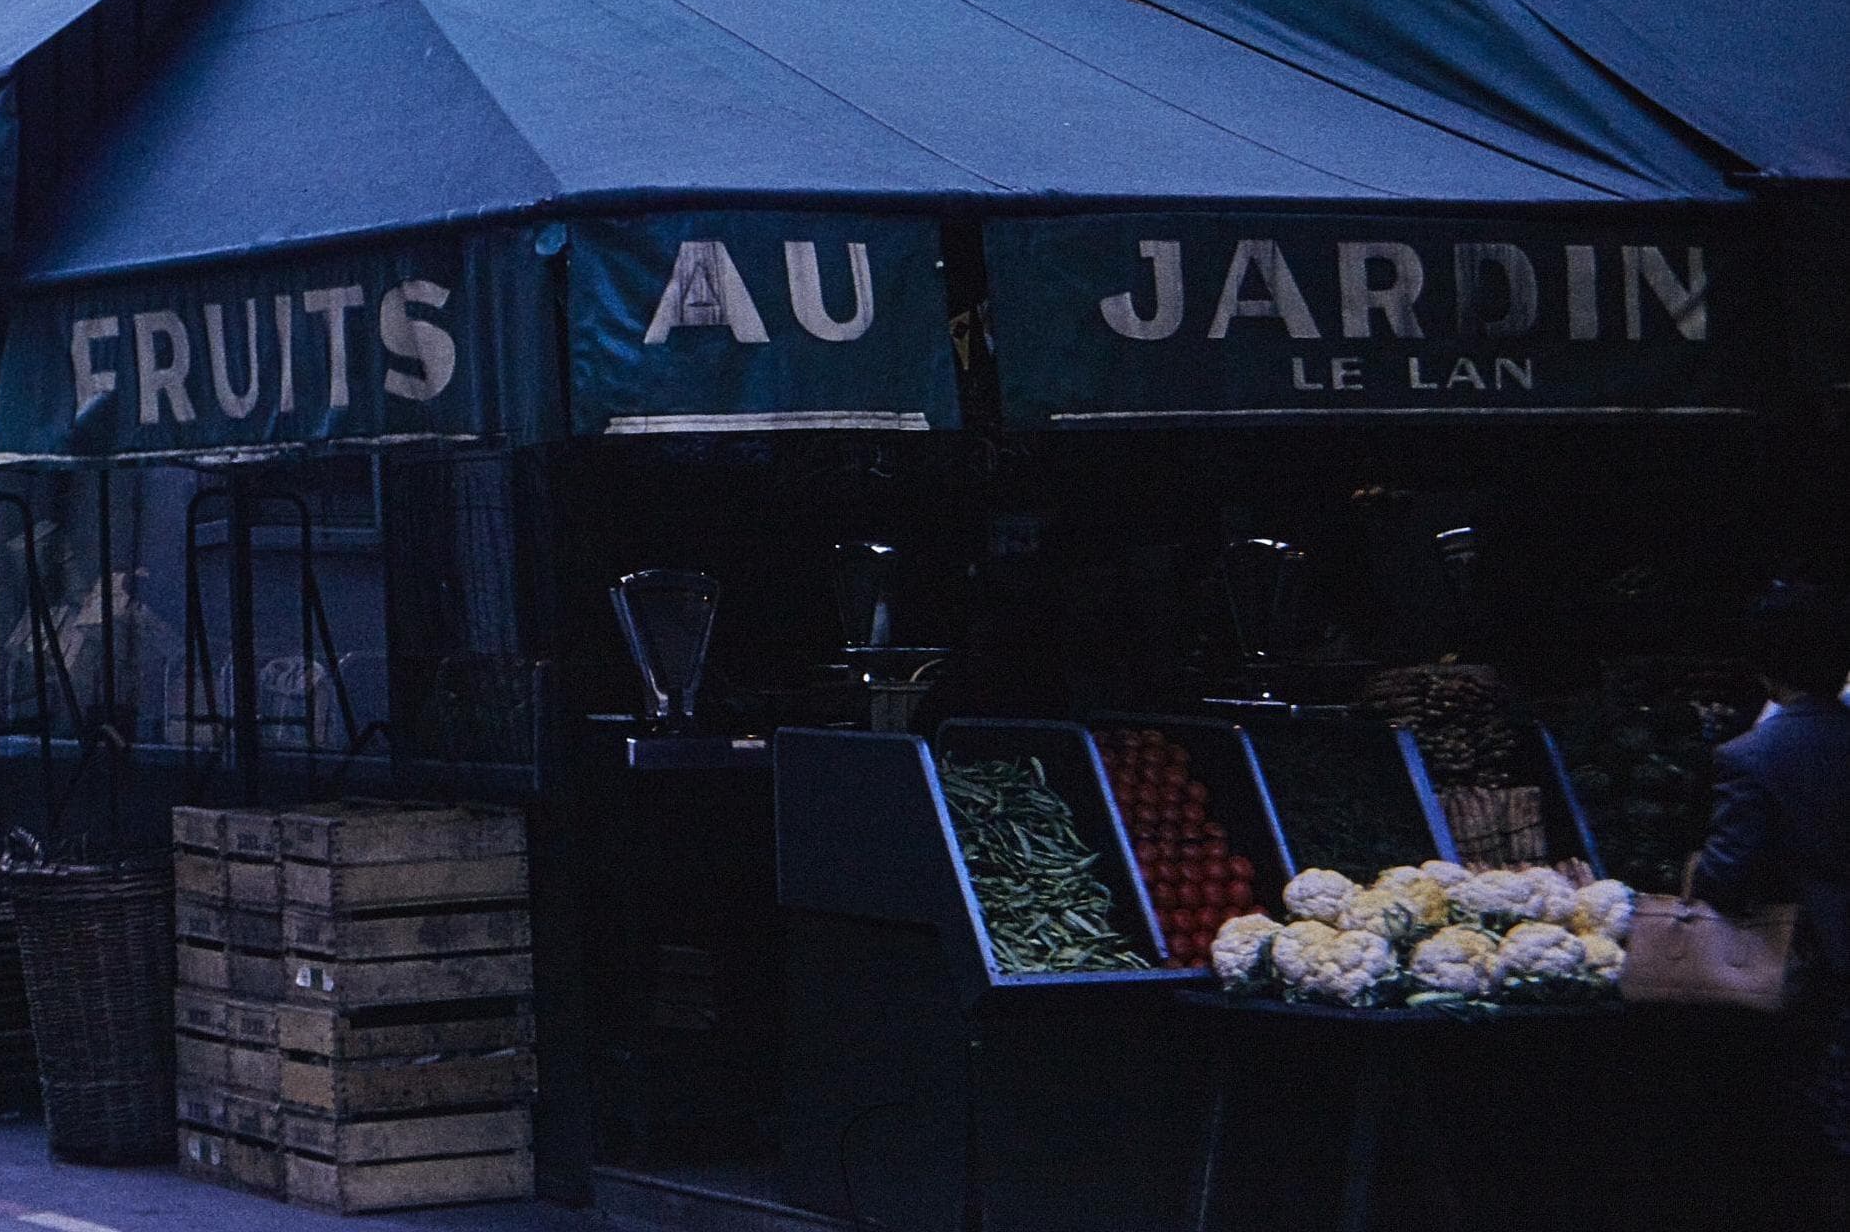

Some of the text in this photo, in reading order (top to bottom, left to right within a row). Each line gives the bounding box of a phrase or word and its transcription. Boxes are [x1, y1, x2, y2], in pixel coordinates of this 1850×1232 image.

[643, 238, 1709, 344] AU JARDIN
[70, 278, 458, 428] FRUITS
[1291, 355, 1536, 391] LE LAN
